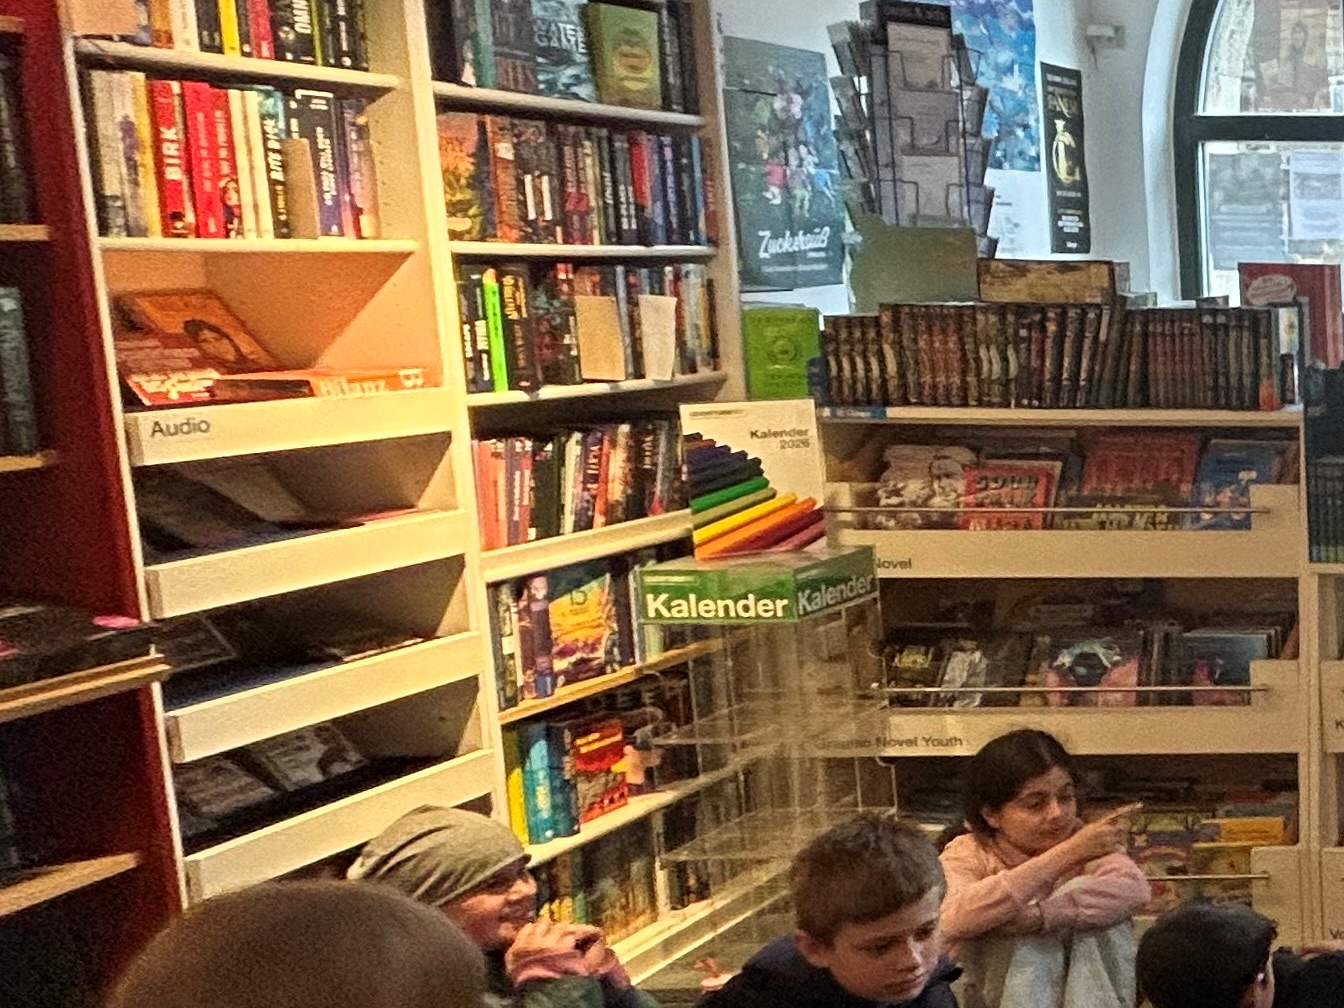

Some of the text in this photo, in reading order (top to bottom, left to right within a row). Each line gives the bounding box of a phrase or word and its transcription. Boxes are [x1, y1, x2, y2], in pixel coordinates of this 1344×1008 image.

[159, 126, 183, 181] BIRK
[150, 418, 211, 438] Audio
[750, 427, 810, 440] Kalender
[645, 593, 789, 619] Kalender
[798, 574, 873, 615] Kalender
[874, 736, 918, 748] Novel
[922, 735, 964, 748] Youth
